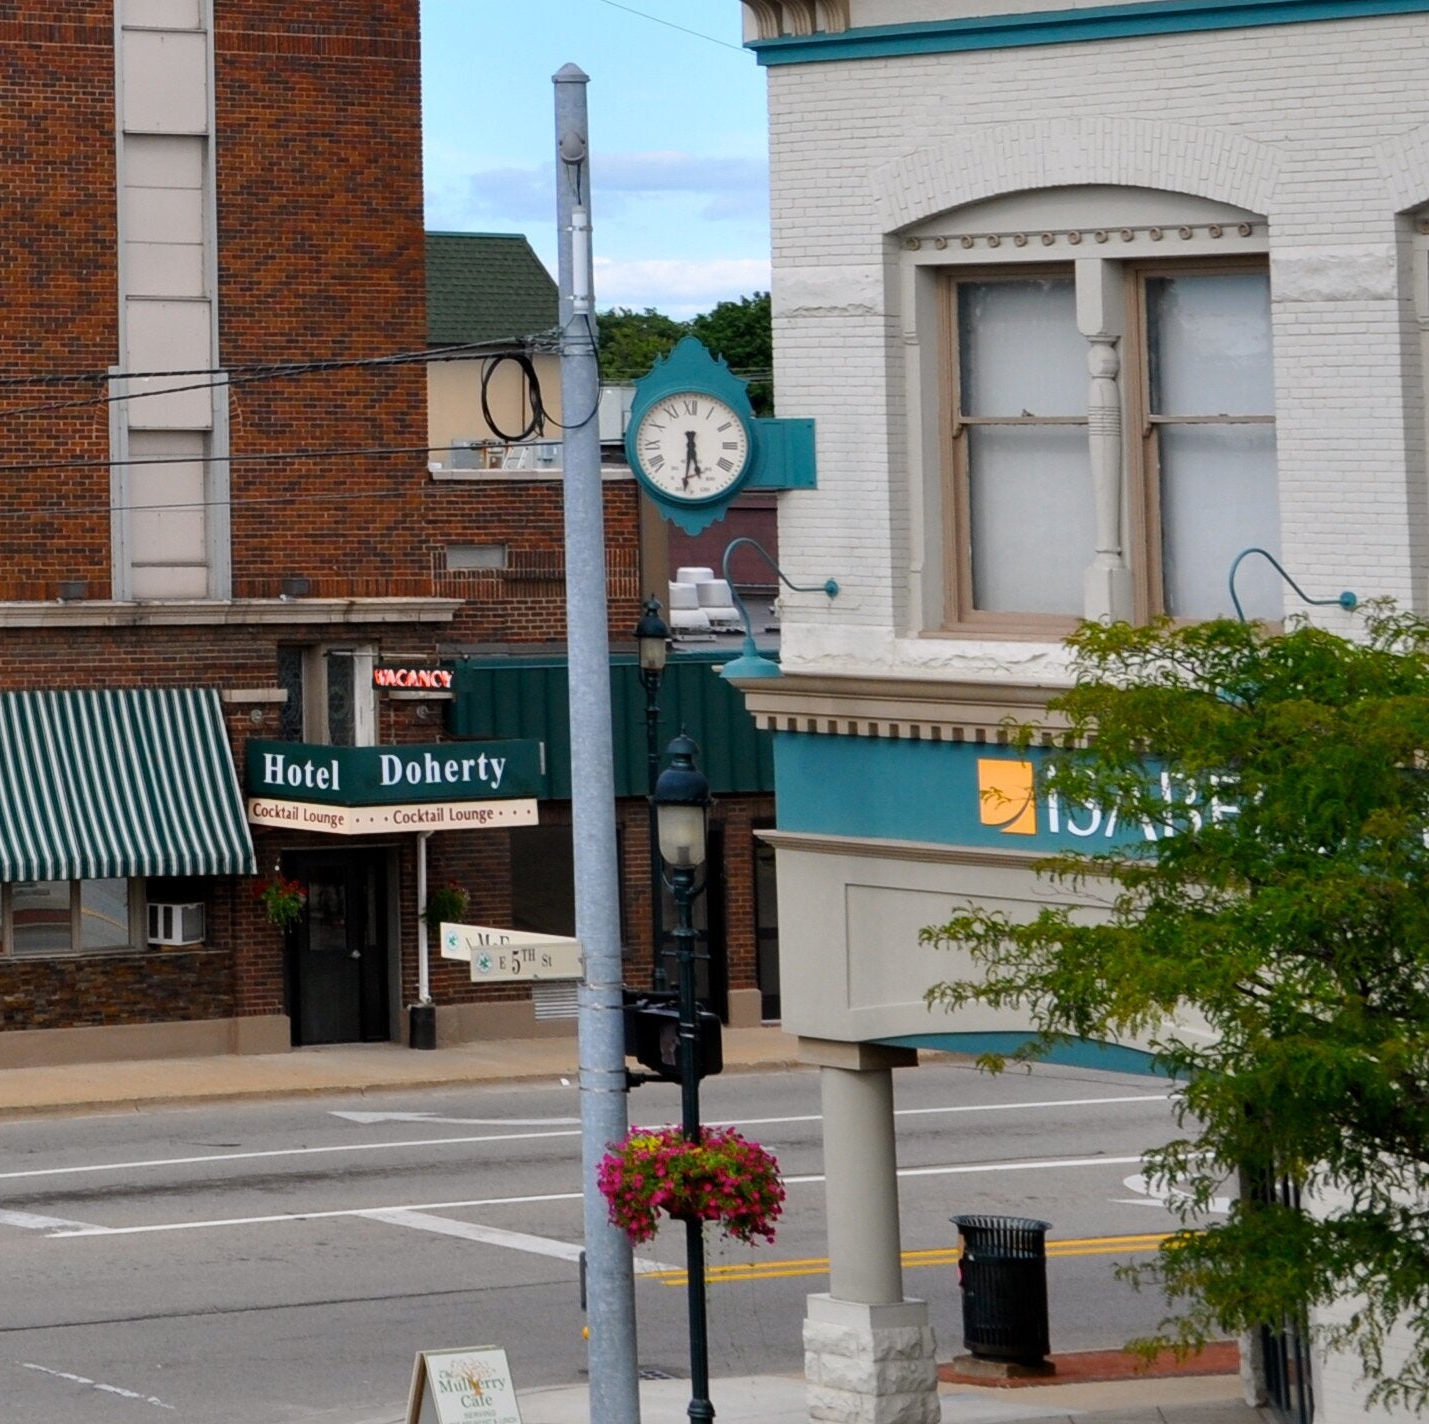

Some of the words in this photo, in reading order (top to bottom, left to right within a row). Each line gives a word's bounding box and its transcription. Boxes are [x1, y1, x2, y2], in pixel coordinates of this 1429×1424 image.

[373, 668, 453, 688] VACANCY
[263, 752, 340, 791] Hotel
[379, 752, 506, 789] Doherty
[252, 802, 299, 821] Cocktail
[303, 809, 345, 827] Lounge
[393, 807, 444, 825] Cocktail
[449, 806, 494, 824] Lounge
[499, 956, 506, 970] E
[512, 948, 536, 975] 5TH
[542, 954, 552, 967] St
[461, 1394, 492, 1409] Cafe
